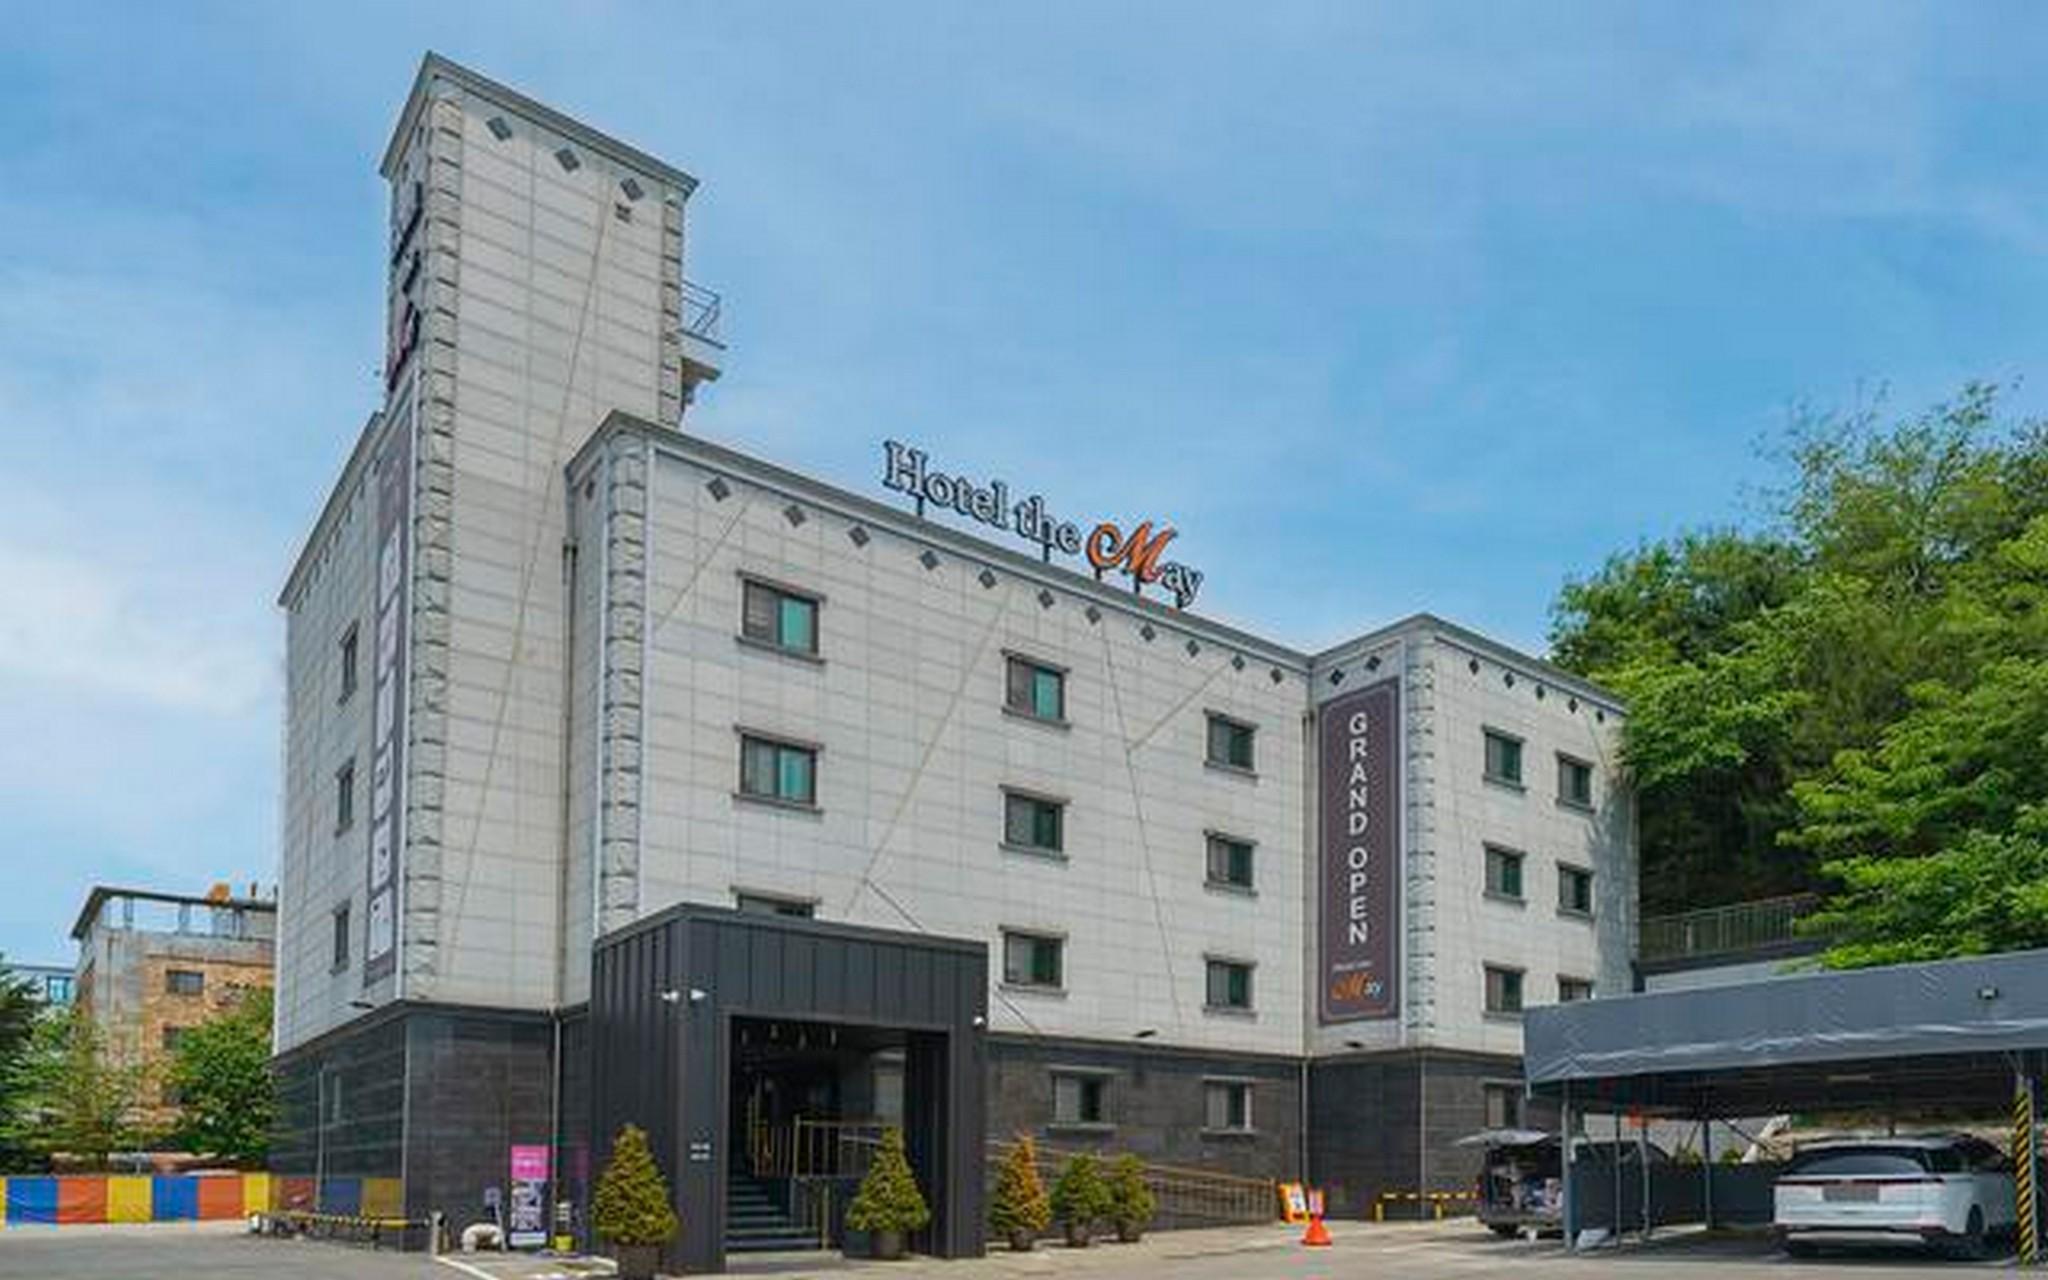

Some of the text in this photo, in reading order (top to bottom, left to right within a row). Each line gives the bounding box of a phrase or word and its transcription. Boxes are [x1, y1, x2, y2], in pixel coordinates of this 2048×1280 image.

[883, 440, 1204, 607] Hotel the May
[1348, 711, 1369, 837] GRAND
[1348, 846, 1369, 945] OPEN
